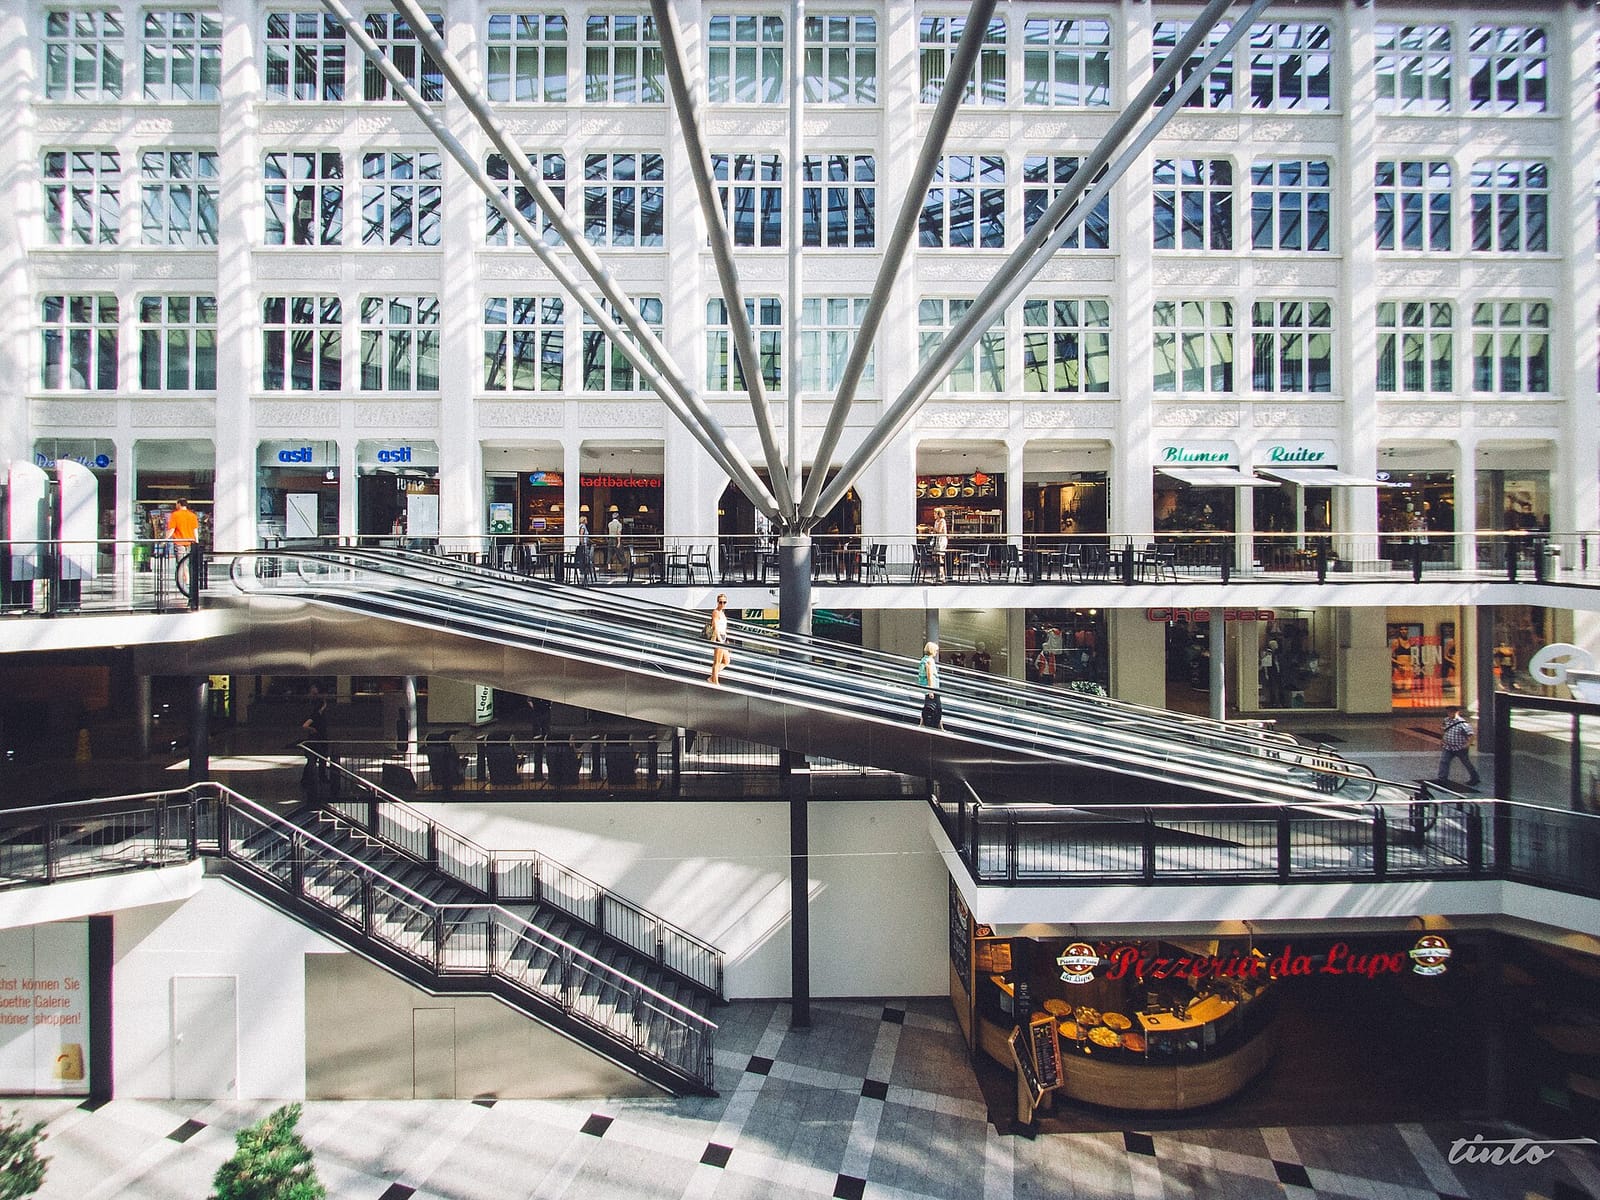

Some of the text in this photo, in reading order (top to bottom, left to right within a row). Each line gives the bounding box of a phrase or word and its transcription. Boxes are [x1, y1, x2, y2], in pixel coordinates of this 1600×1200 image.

[278, 447, 313, 463] asti
[378, 447, 412, 463] asti
[1162, 446, 1325, 462] Blumen Ruiter
[1147, 607, 1276, 622] Chesea
[1106, 946, 1259, 980] Pizzeria
[1269, 944, 1313, 977] da
[22, 978, 60, 991] können
[64, 976, 80, 991] Sie
[34, 995, 71, 1008] Galerie
